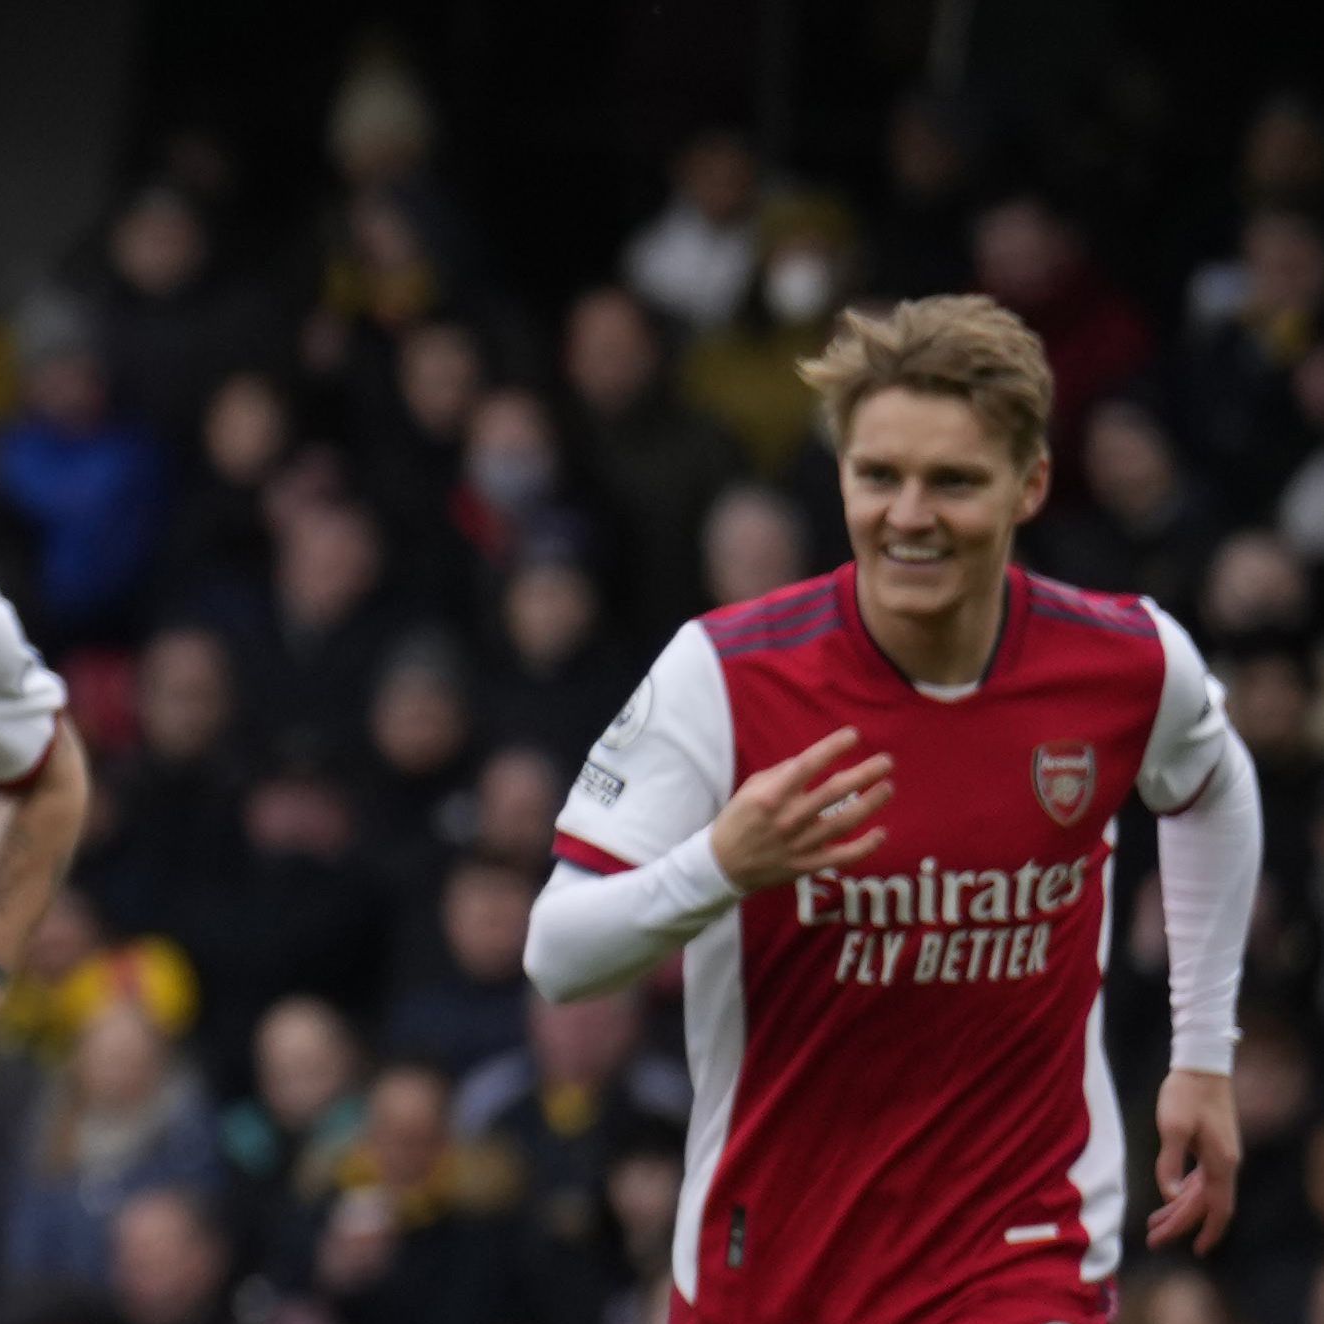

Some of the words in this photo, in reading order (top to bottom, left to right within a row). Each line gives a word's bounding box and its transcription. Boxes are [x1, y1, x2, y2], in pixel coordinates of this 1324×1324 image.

[794, 855, 1090, 928] Emirates
[834, 928, 906, 987] FLY
[913, 920, 1053, 987] BETTER
